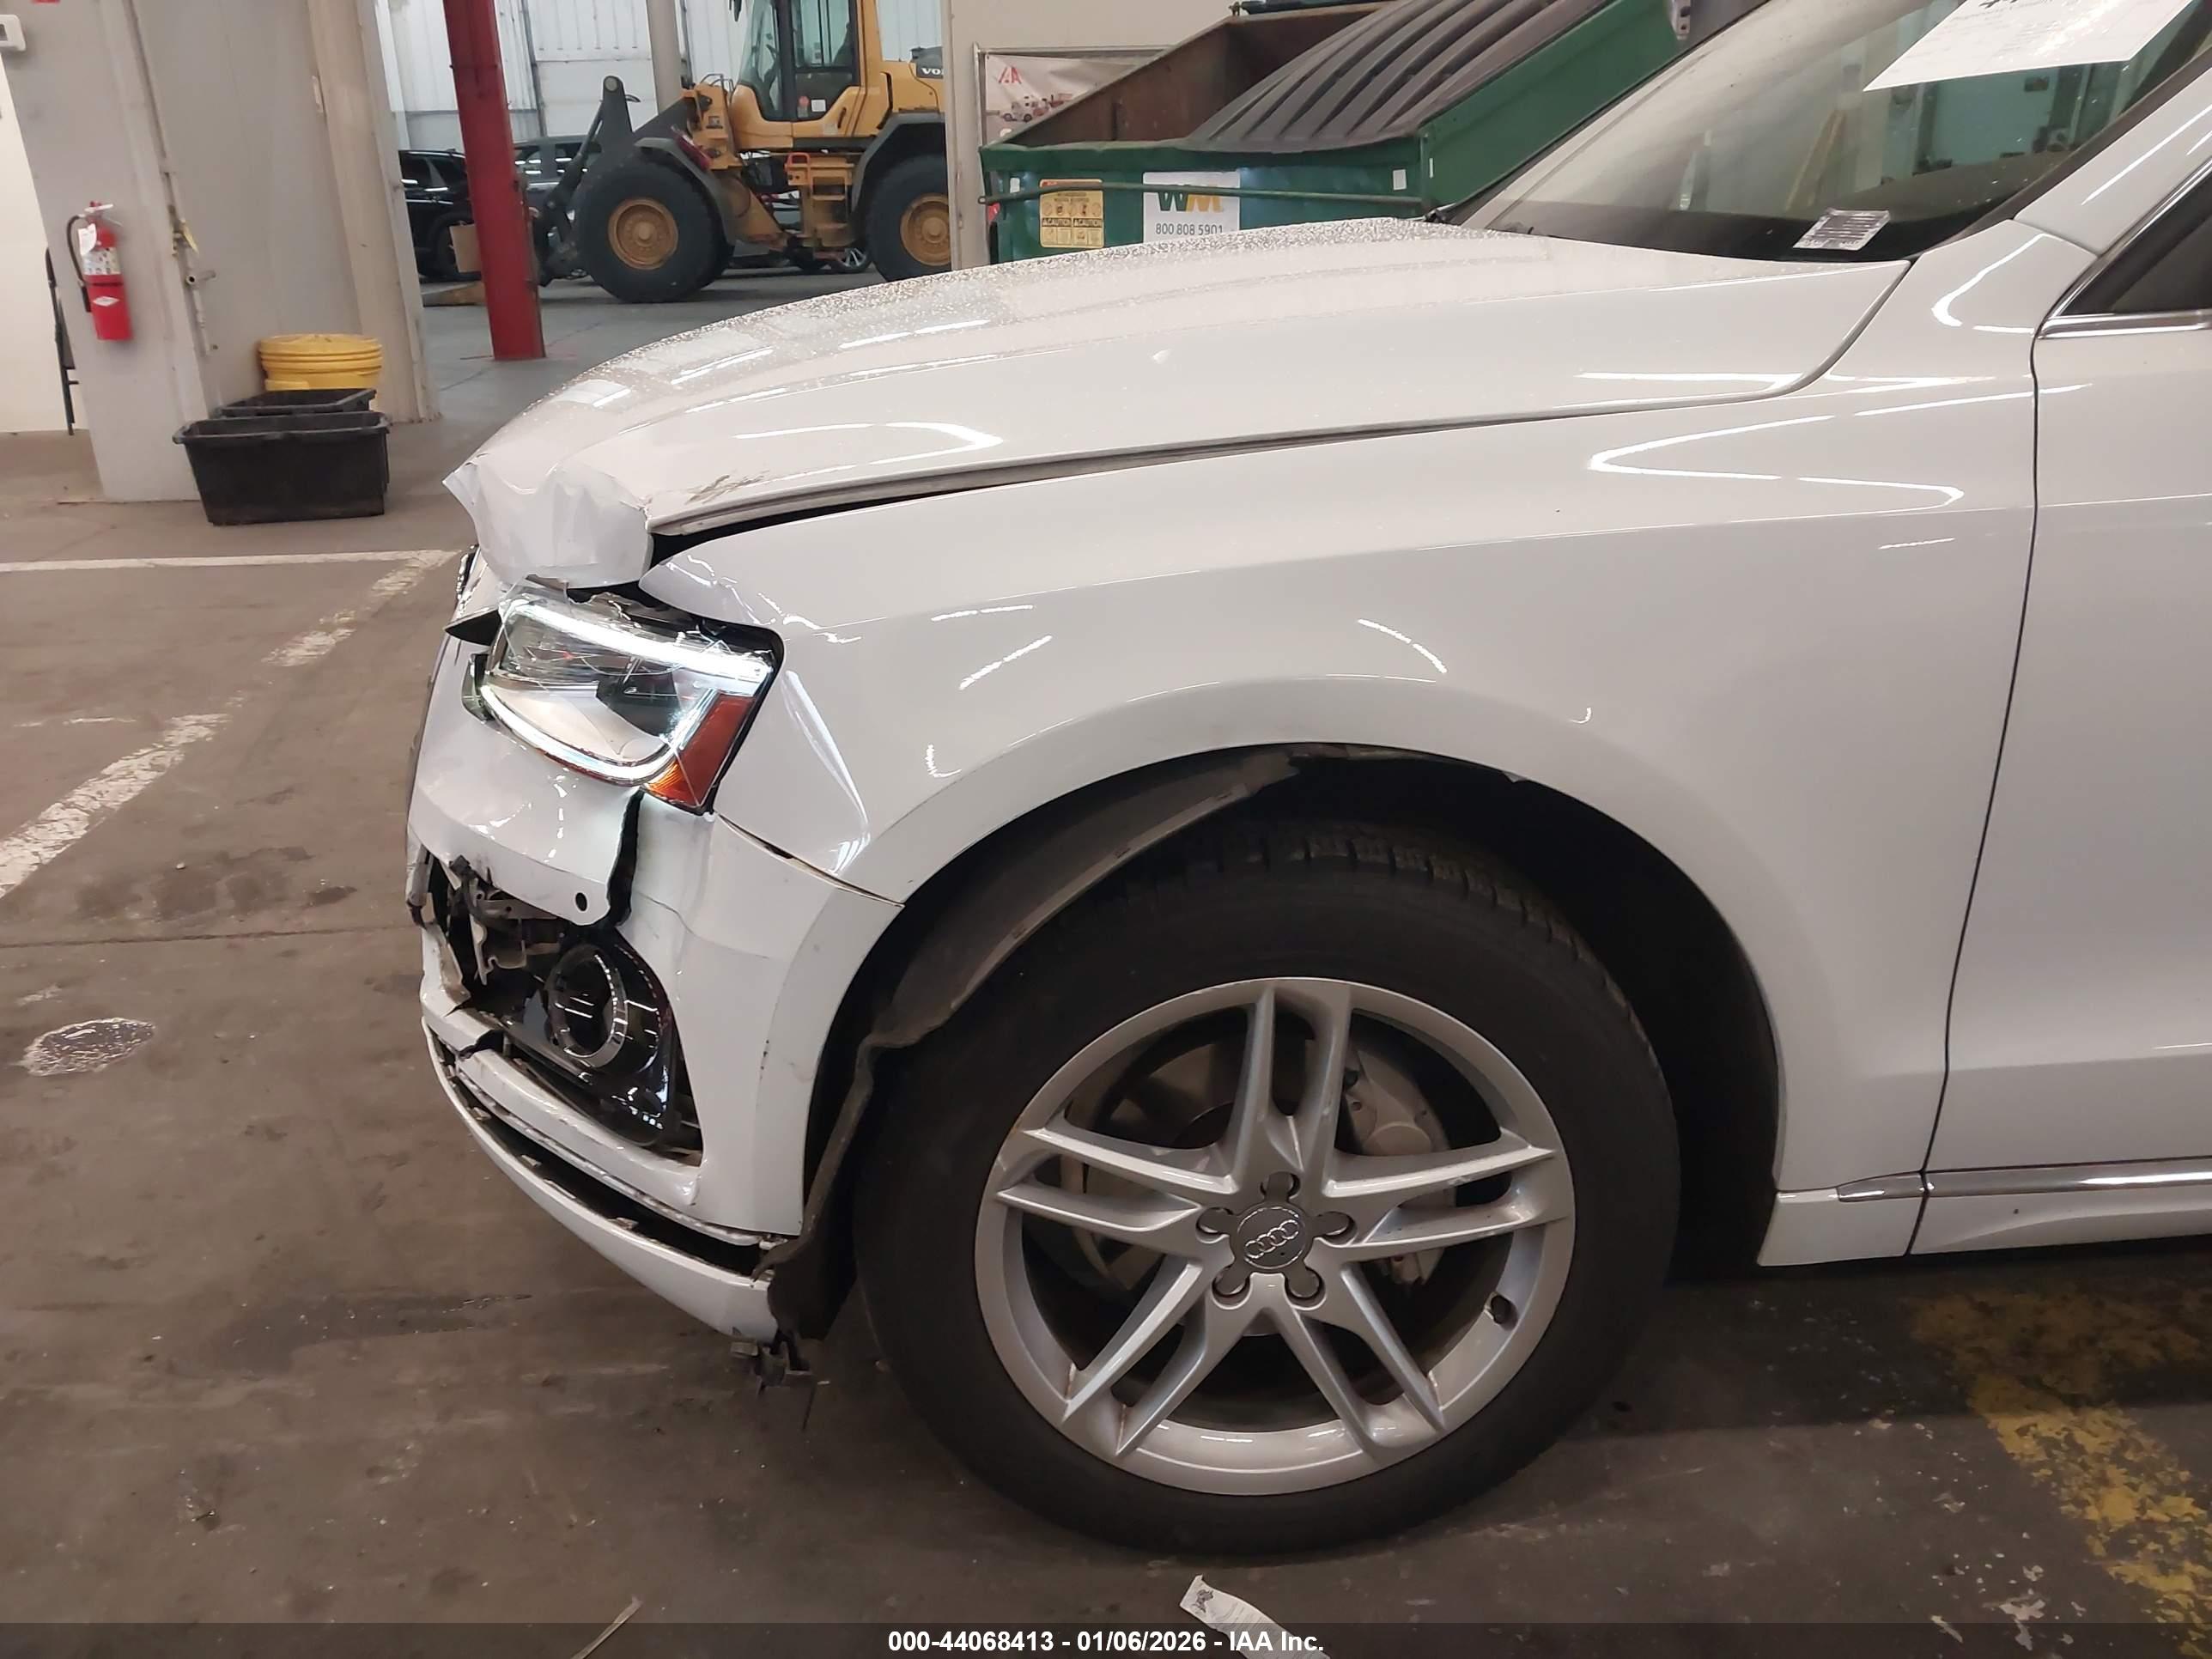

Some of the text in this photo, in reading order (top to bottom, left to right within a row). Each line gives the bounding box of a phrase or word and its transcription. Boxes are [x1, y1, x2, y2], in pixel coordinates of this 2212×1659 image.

[1158, 191, 1224, 213] WM
[1156, 223, 1223, 235] 800 808 5901
